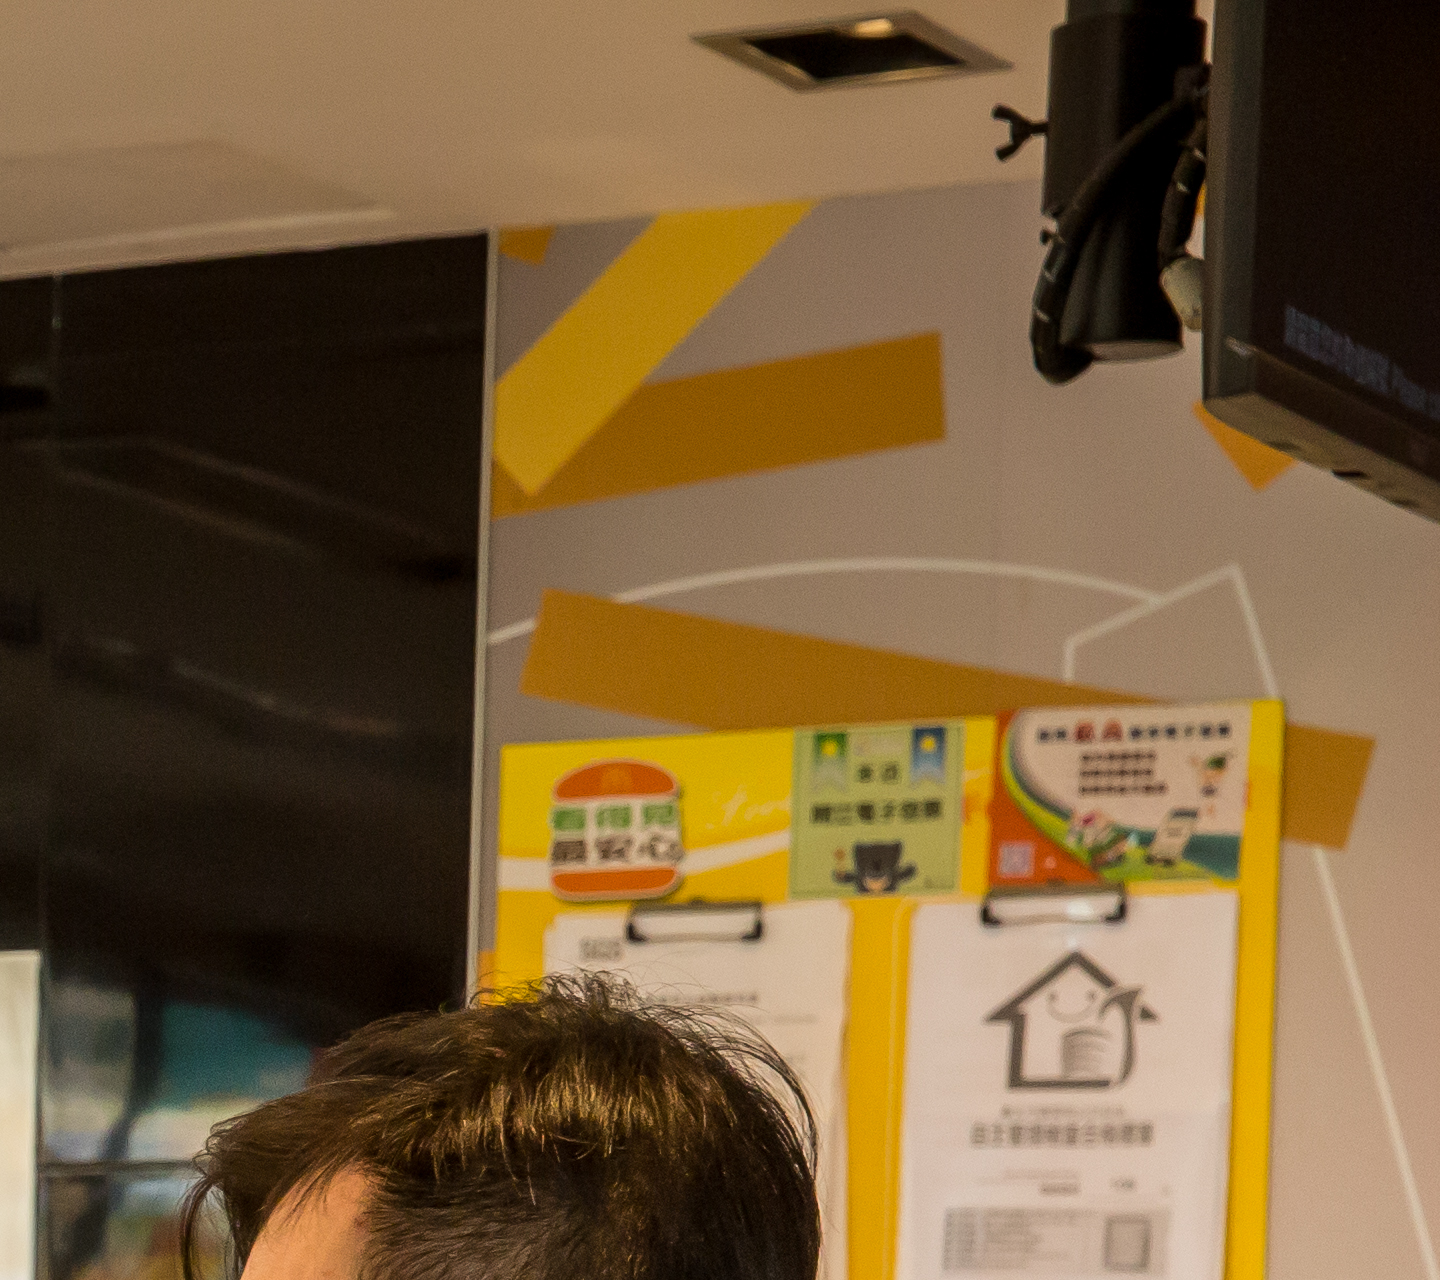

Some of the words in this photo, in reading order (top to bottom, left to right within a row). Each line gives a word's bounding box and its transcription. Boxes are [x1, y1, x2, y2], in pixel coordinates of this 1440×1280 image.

[552, 803, 676, 831] 看得見
[551, 834, 682, 866] 最安心
